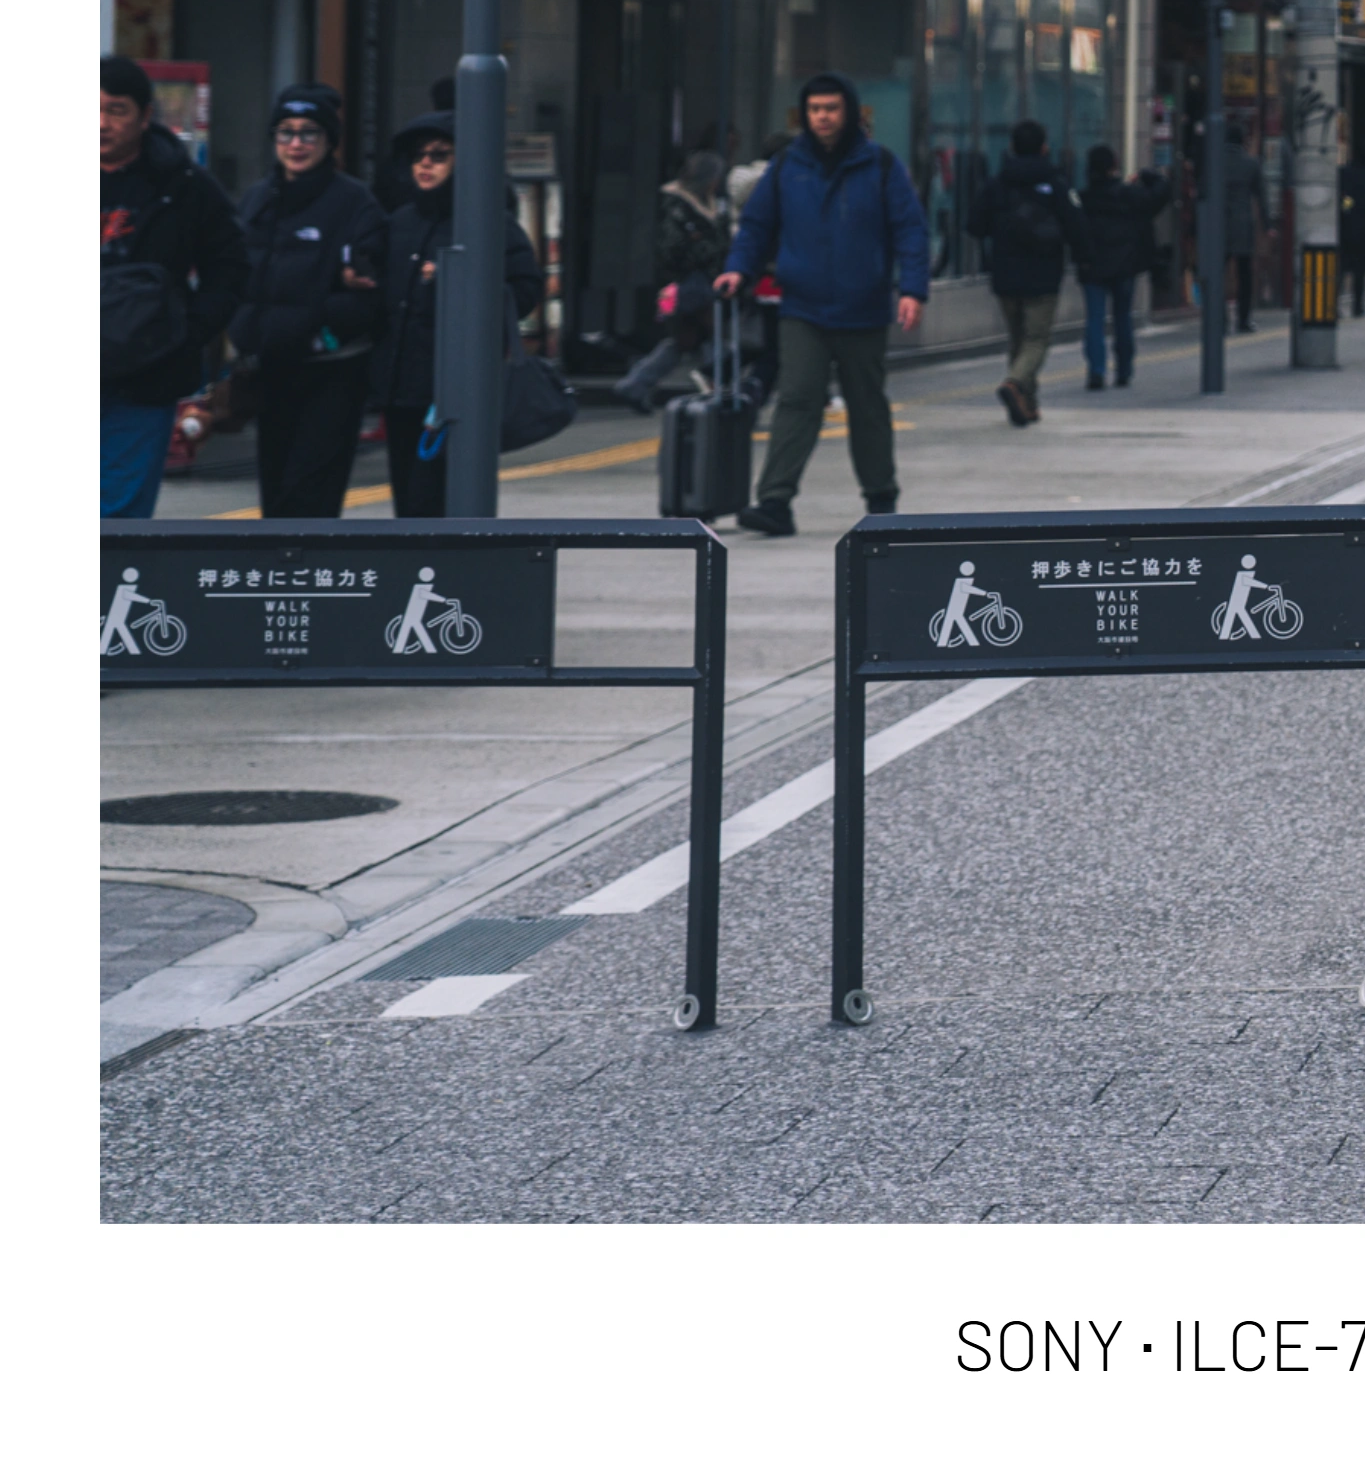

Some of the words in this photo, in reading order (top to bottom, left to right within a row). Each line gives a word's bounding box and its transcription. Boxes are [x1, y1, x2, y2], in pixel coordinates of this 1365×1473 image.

[1032, 558, 1202, 579] 押歩きにご協力を
[199, 569, 377, 587] 押歩きにご協力を
[1096, 590, 1138, 601] WALK
[266, 601, 309, 612] WALK
[1097, 604, 1138, 616] YOUR
[266, 616, 309, 627] YOUR
[1097, 618, 1138, 631] BIKE
[265, 630, 308, 642] BIKE
